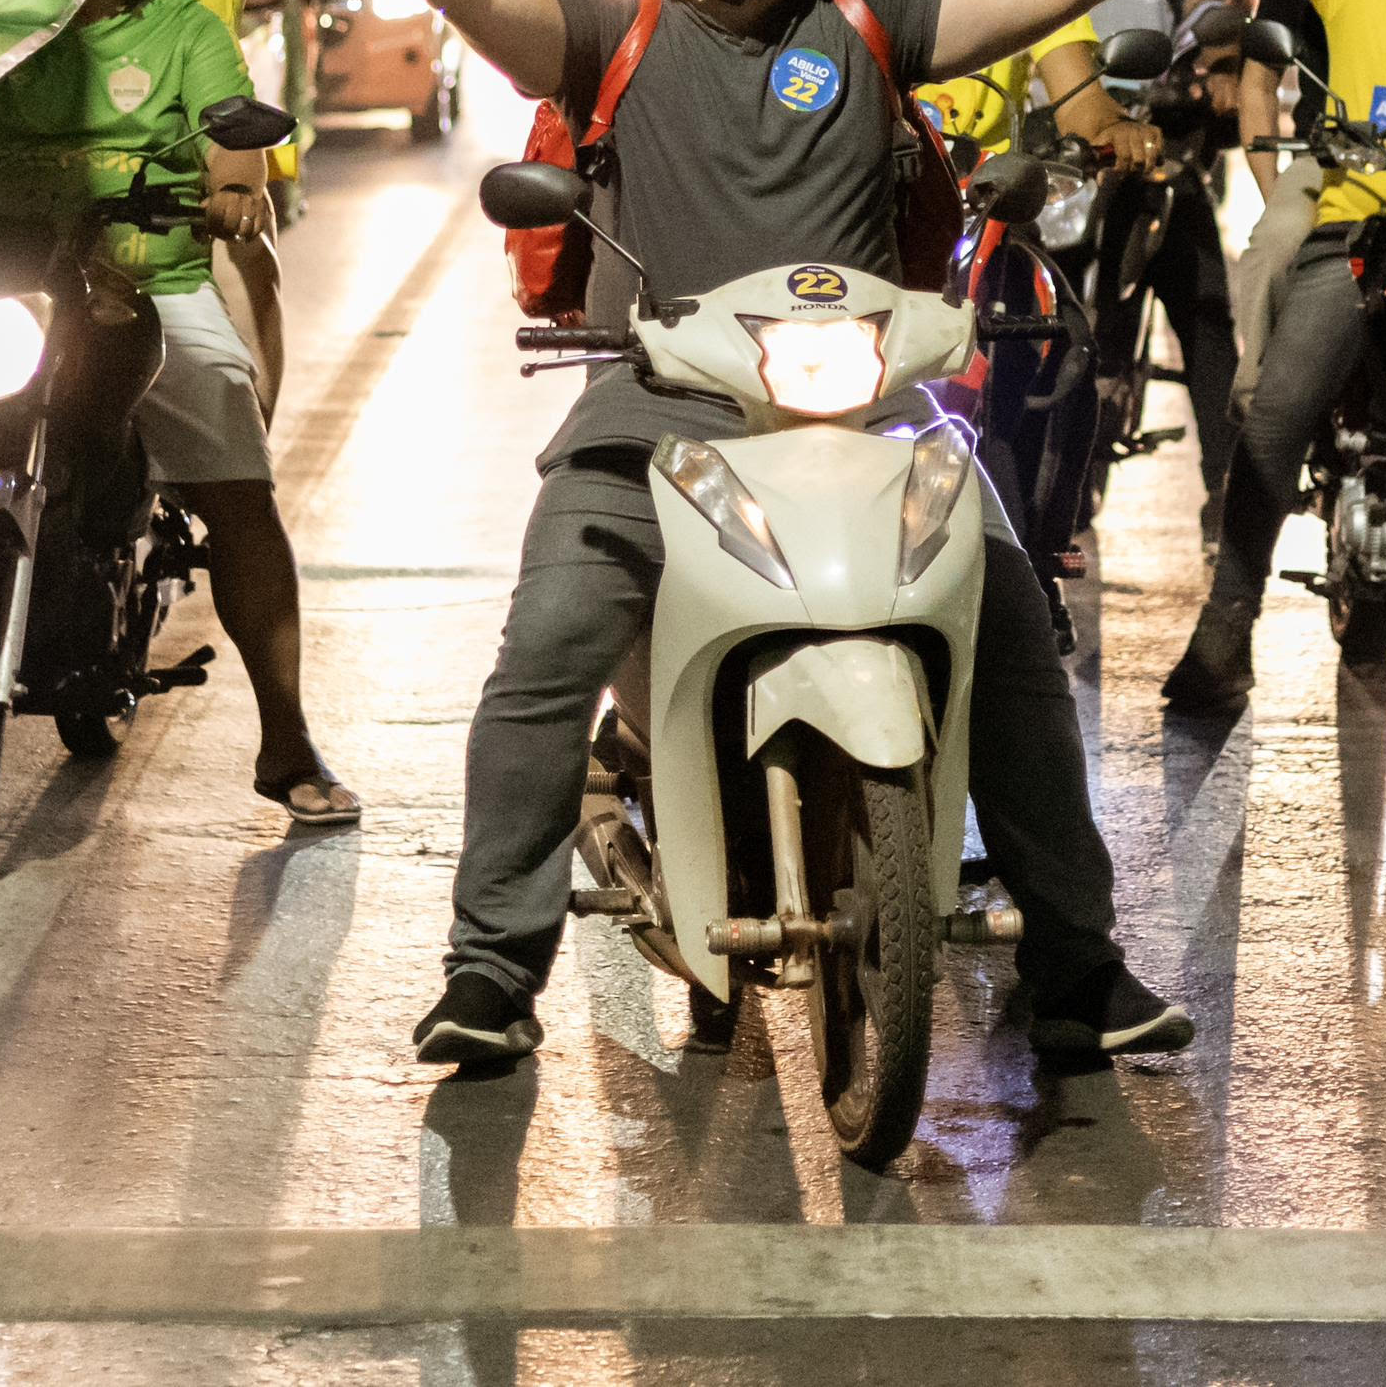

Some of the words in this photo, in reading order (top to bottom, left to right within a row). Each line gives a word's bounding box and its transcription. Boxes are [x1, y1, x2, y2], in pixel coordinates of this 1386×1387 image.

[788, 56, 830, 79] ABILIO
[782, 76, 819, 105] 22
[794, 272, 844, 297] 22
[791, 303, 849, 312] HONDA
